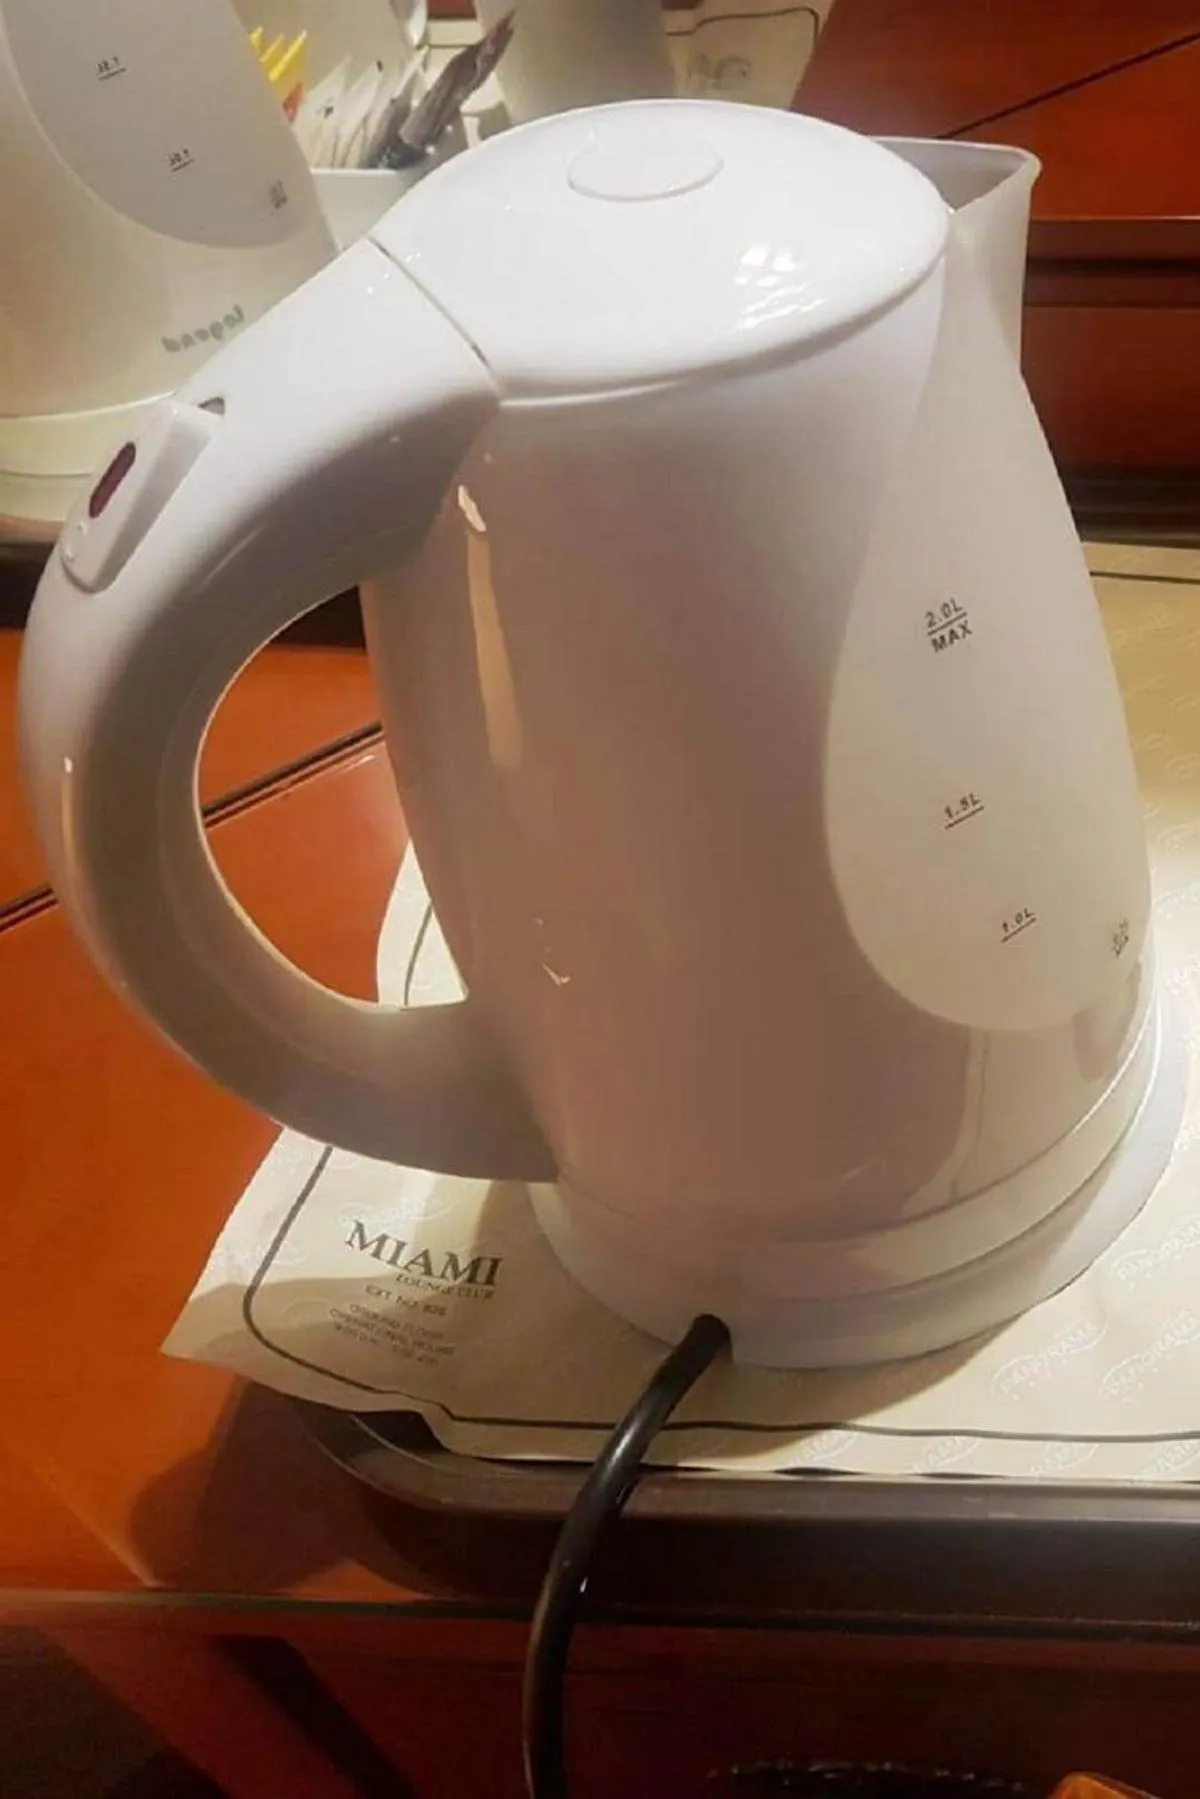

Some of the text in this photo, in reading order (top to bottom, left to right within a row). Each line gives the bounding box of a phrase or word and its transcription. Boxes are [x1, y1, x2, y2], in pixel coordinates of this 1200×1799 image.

[924, 598, 964, 629] 2.0L
[930, 619, 973, 653] MAX
[344, 1219, 503, 1286] MIAMI
